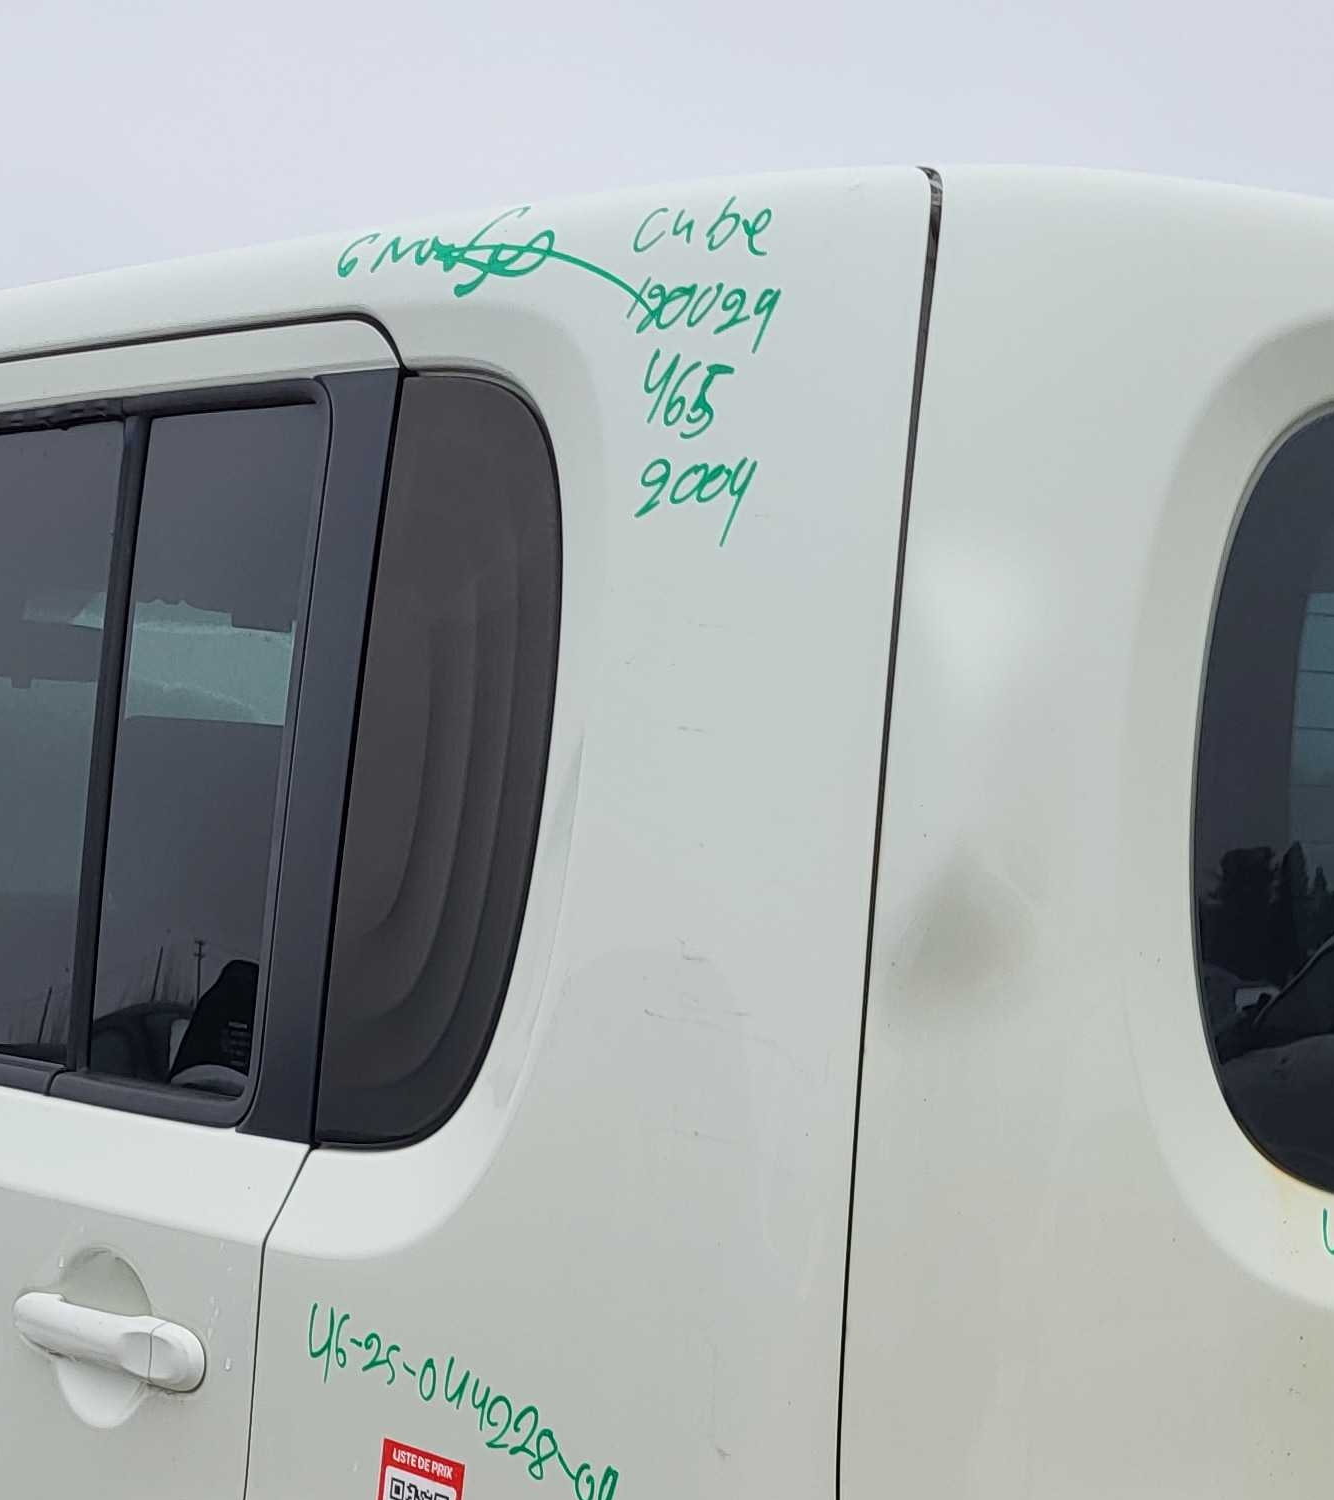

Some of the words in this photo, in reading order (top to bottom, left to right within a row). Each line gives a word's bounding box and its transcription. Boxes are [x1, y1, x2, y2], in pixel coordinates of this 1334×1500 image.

[644, 348, 734, 439] 465
[392, 1447, 417, 1468] LISTE
[417, 1455, 431, 1473] DE
[431, 1460, 453, 1480] PRIX
